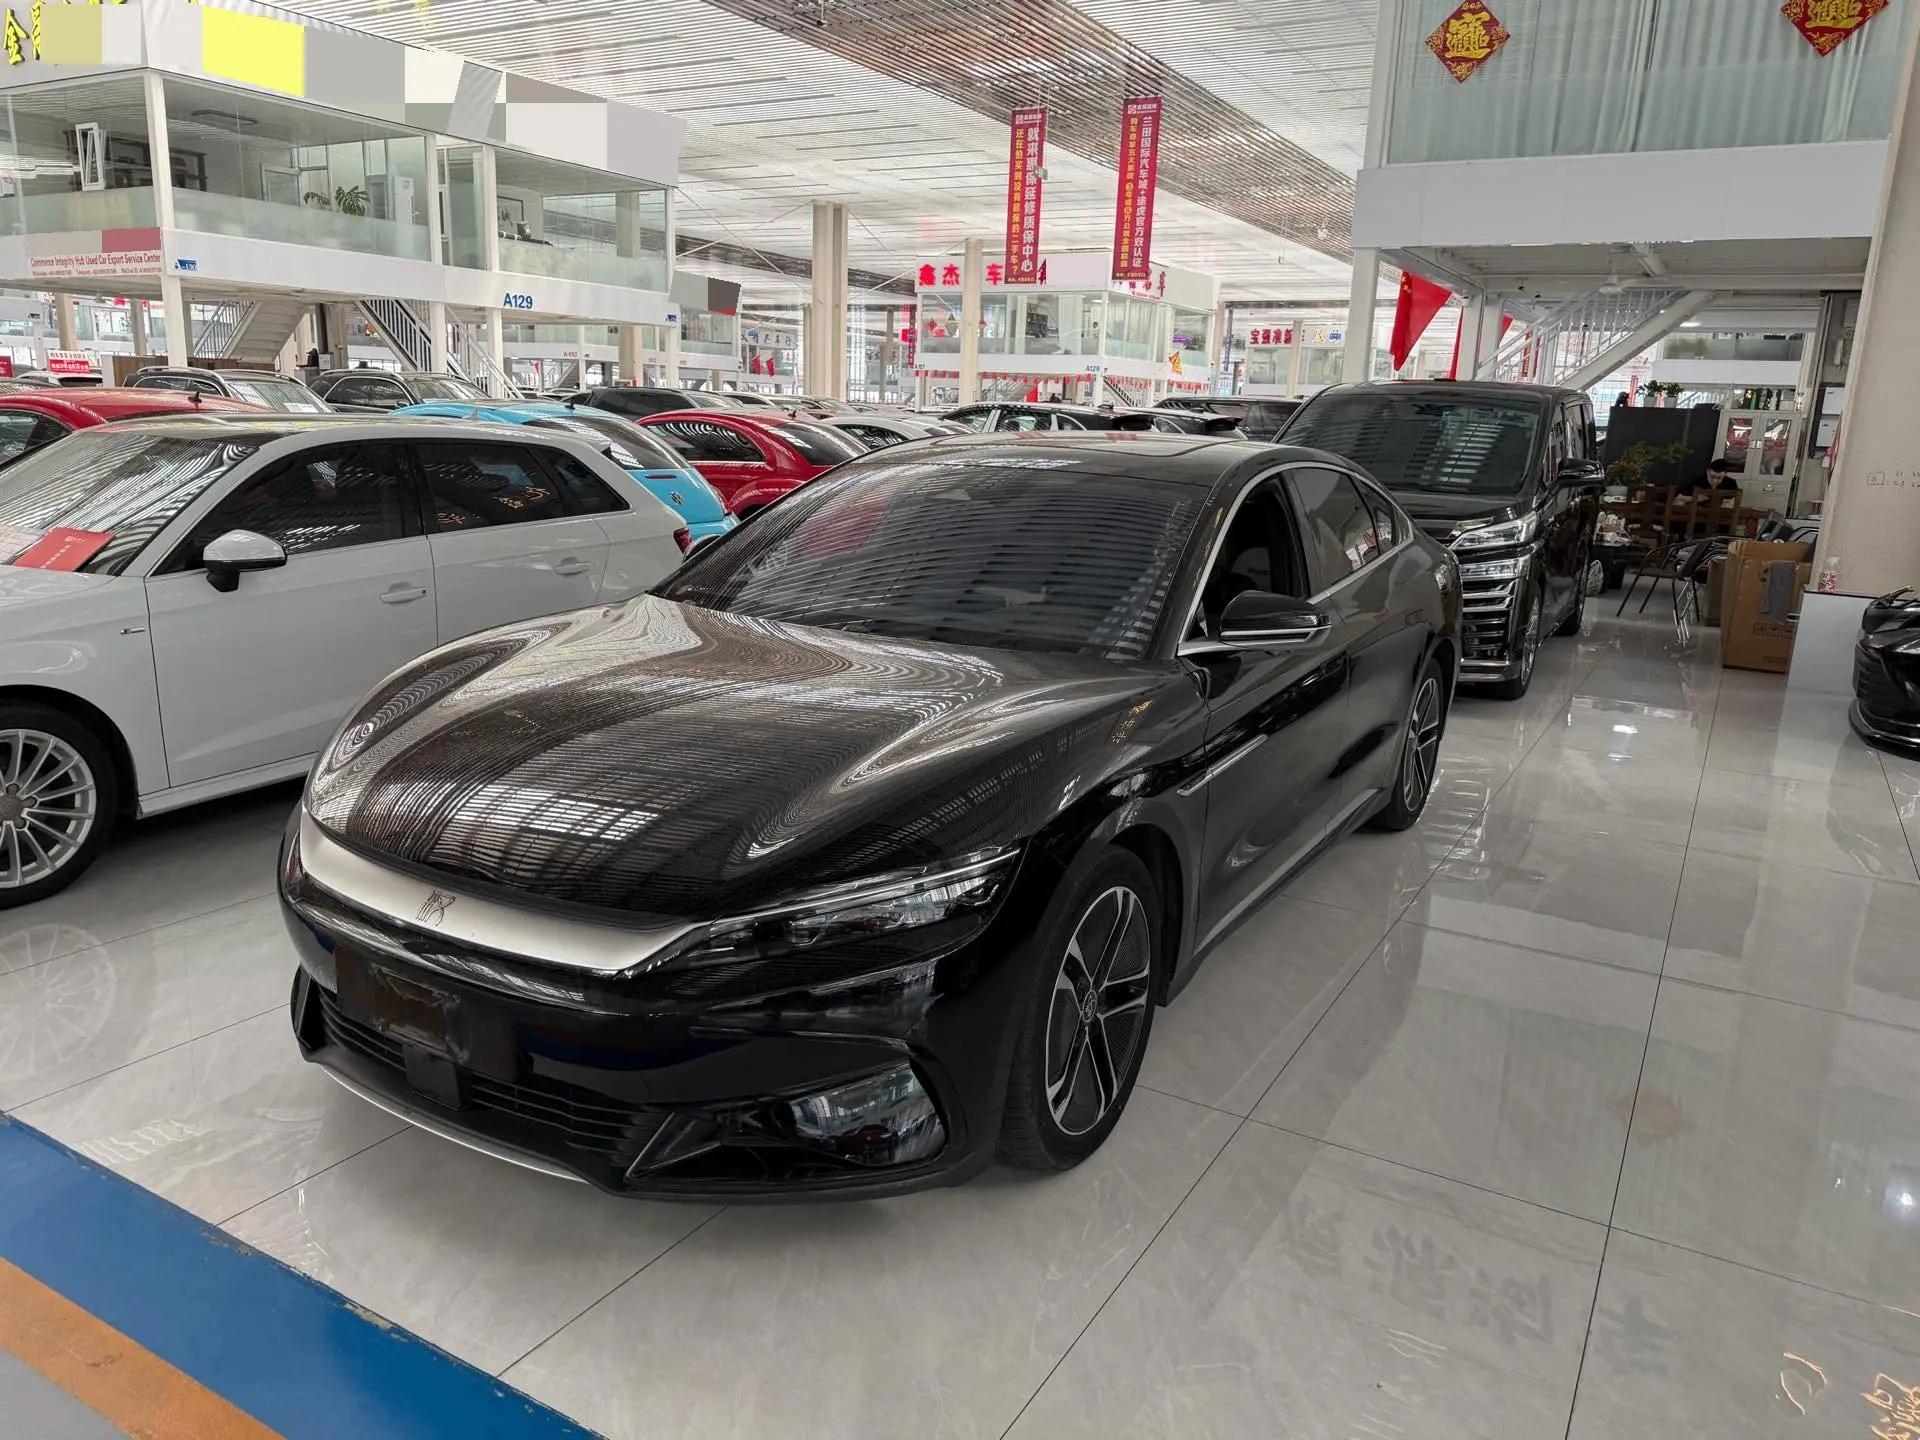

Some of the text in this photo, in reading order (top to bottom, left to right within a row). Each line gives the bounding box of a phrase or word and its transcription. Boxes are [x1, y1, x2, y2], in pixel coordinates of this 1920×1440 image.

[31, 252, 161, 268] Commerce Integrity Hub Used Car Export Service Center
[503, 292, 533, 309] A129
